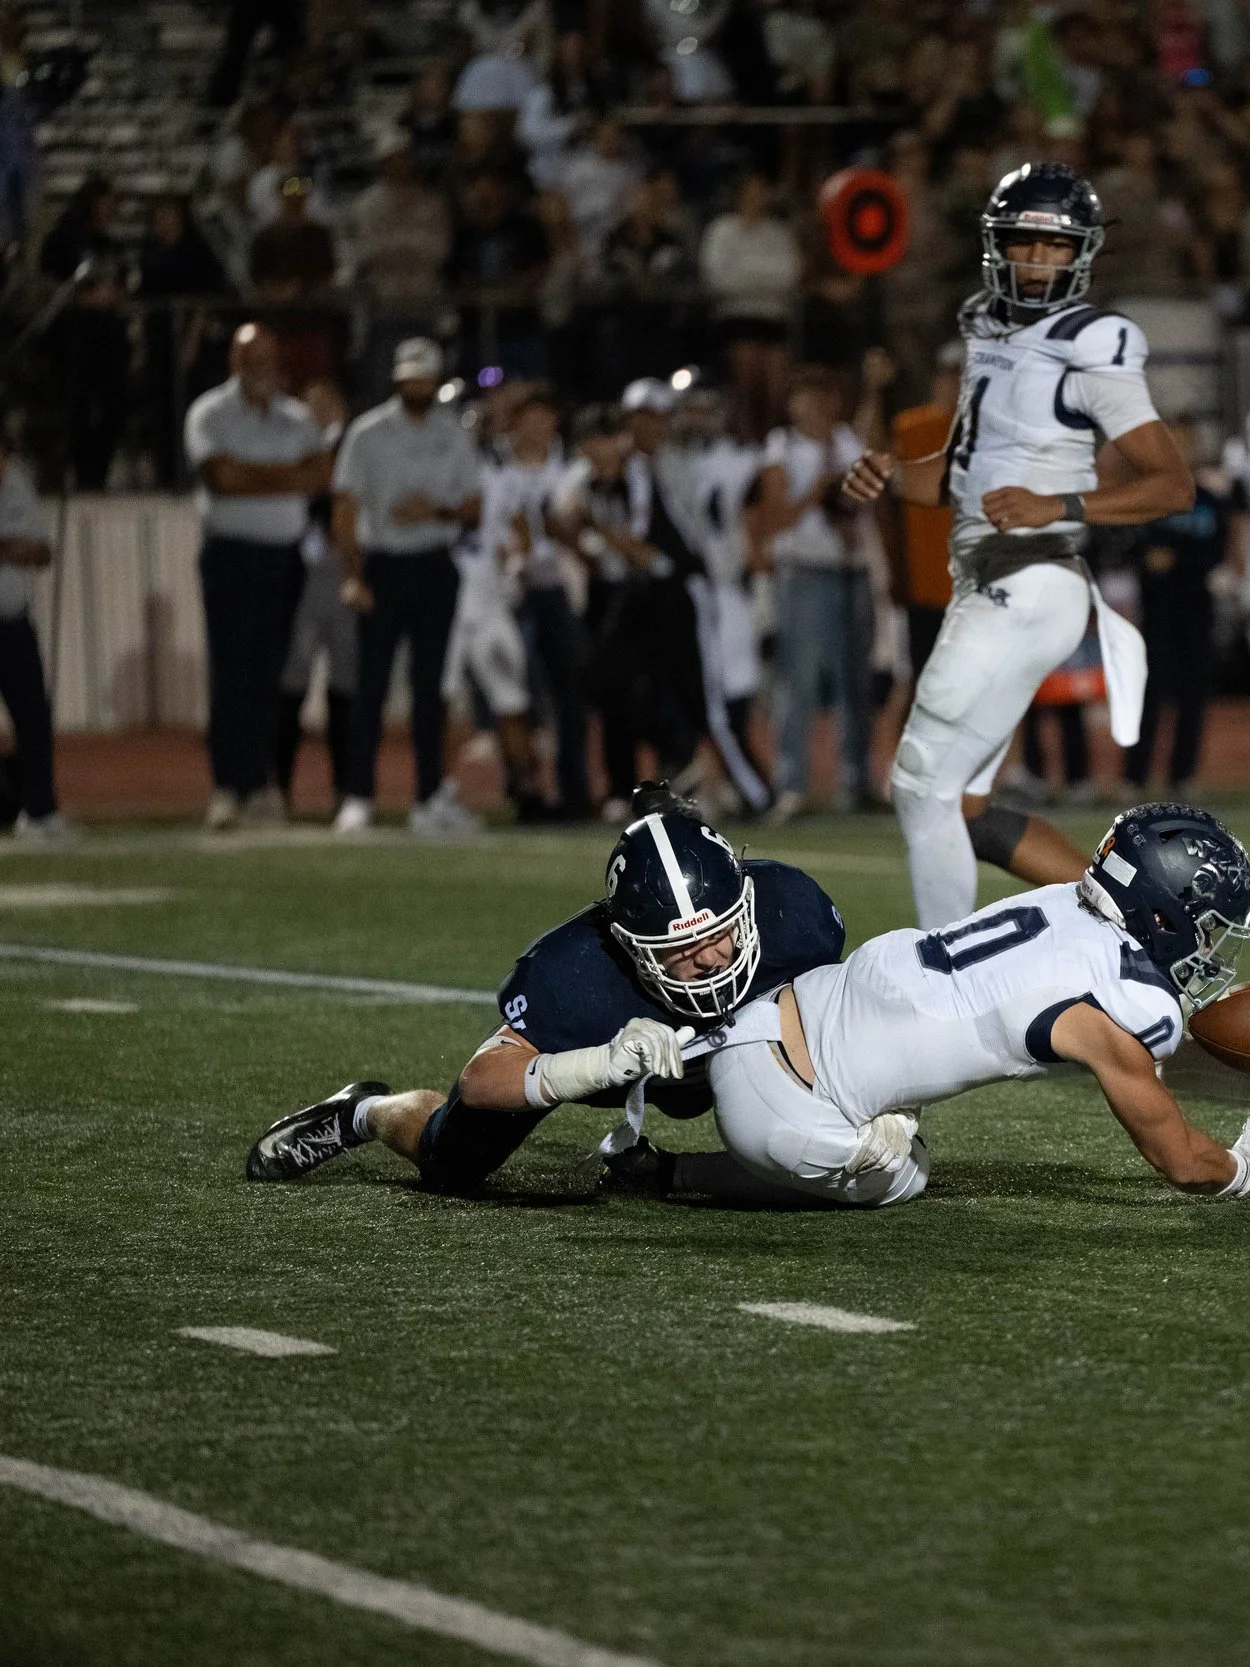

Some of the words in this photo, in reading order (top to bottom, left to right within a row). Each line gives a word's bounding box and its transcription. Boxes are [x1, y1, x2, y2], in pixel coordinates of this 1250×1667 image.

[1113, 327, 1127, 366] 1
[604, 854, 627, 898] 6
[672, 912, 710, 931] Riddell
[915, 905, 1051, 975] 0
